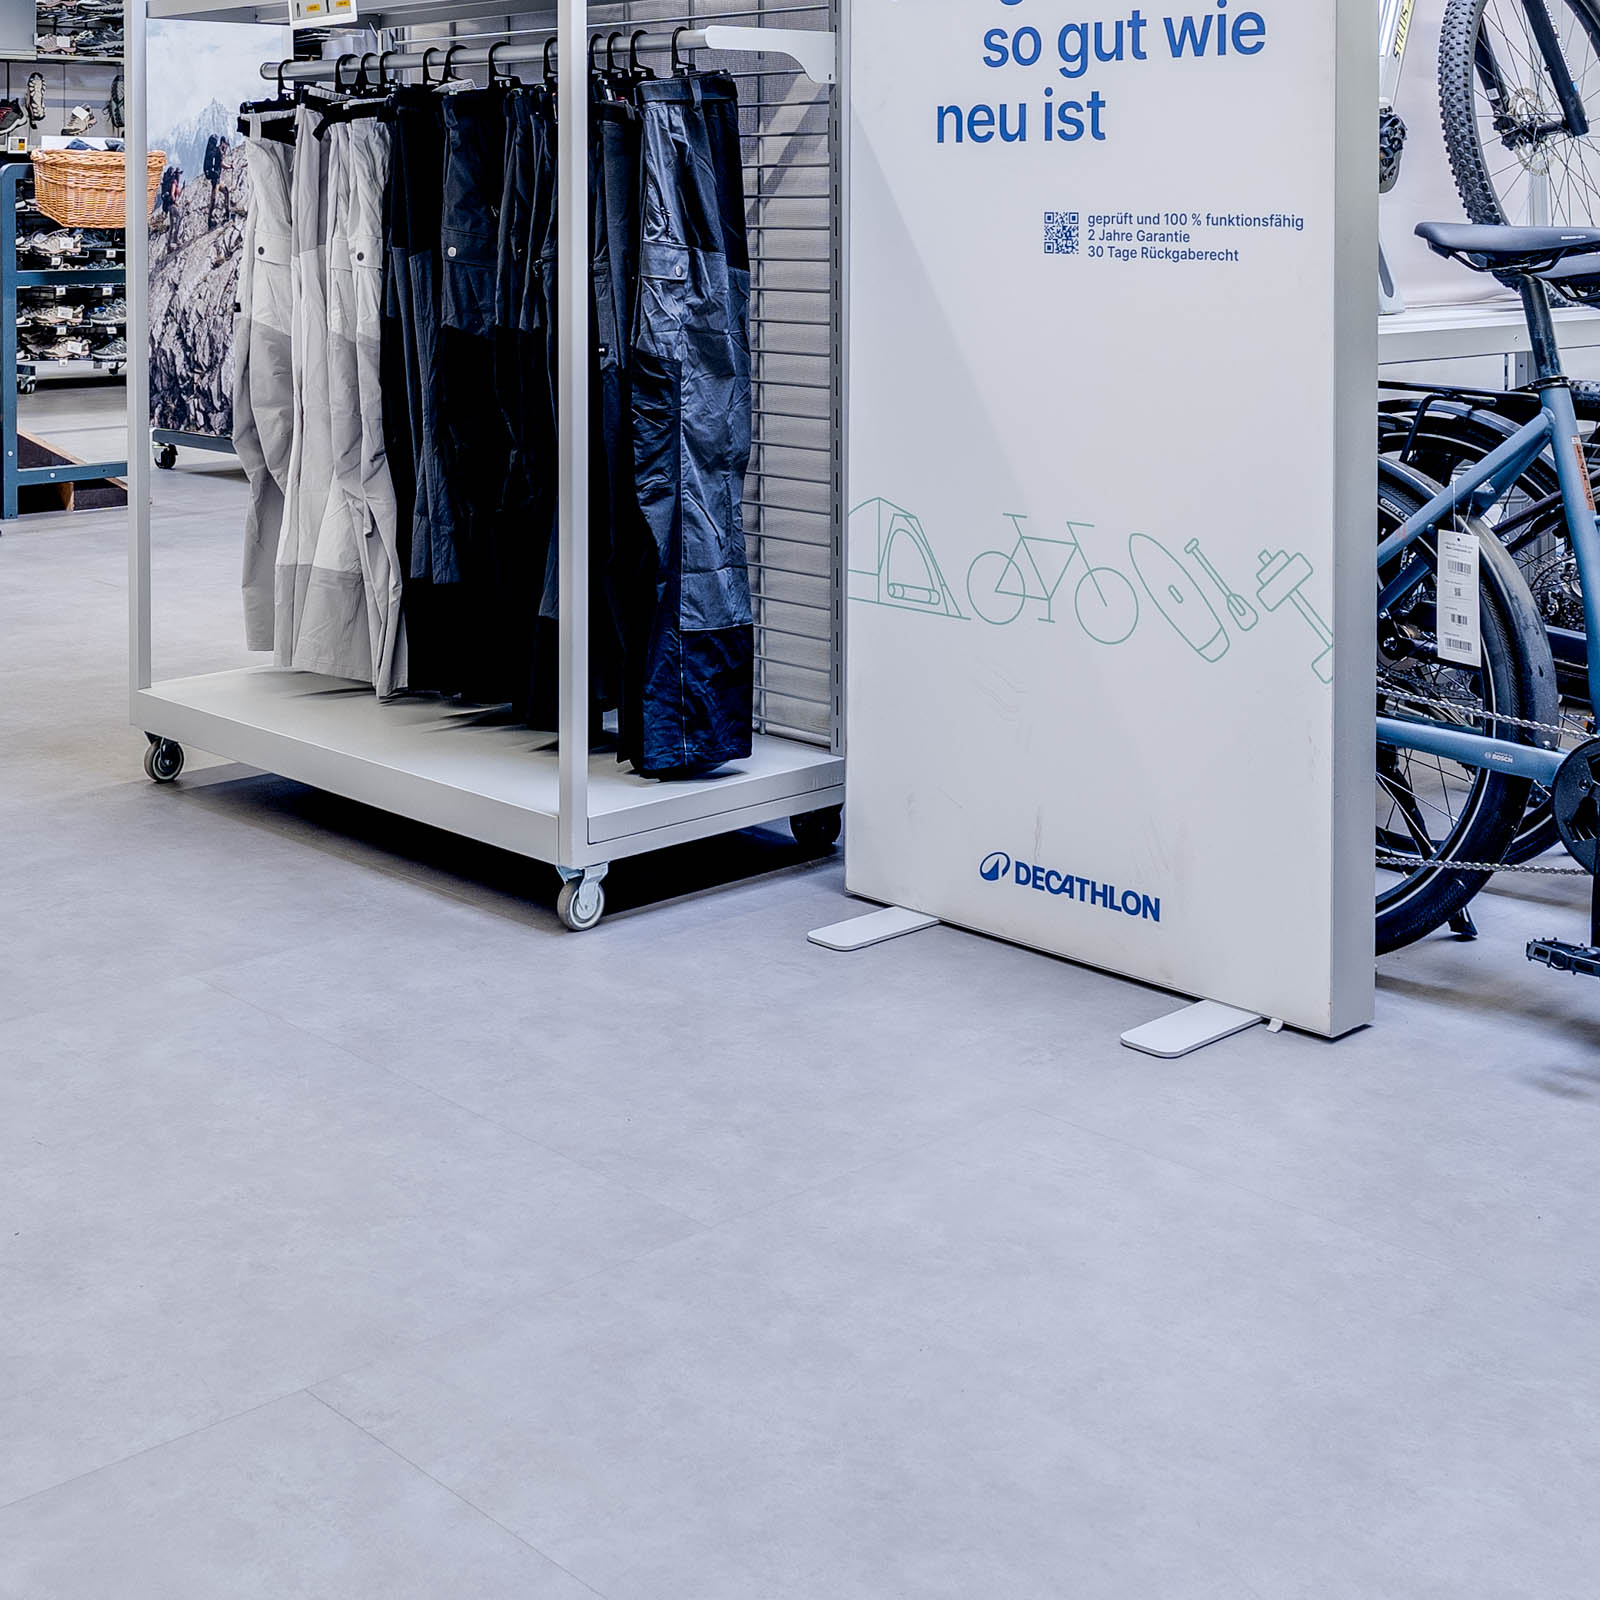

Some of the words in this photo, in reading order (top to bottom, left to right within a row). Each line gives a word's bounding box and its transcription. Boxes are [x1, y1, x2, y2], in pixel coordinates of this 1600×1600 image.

[983, 23, 1042, 68] so
[1057, 9, 1147, 78] gut
[937, 102, 1027, 144] neu
[1043, 86, 1106, 141] ist
[1087, 211, 1134, 227] geprüft
[1136, 213, 1161, 226] und
[1163, 213, 1188, 226] 100
[1191, 213, 1202, 226] %
[1205, 213, 1304, 231] funktionsfähig
[1087, 229, 1096, 241] 2
[1098, 229, 1133, 242] Jahre
[1136, 229, 1191, 243] Garantie
[1087, 246, 1104, 257] 30
[1107, 246, 1138, 261] Tage
[1140, 246, 1239, 262] Rückgaberecht
[1015, 860, 1160, 923] DECATHLON
